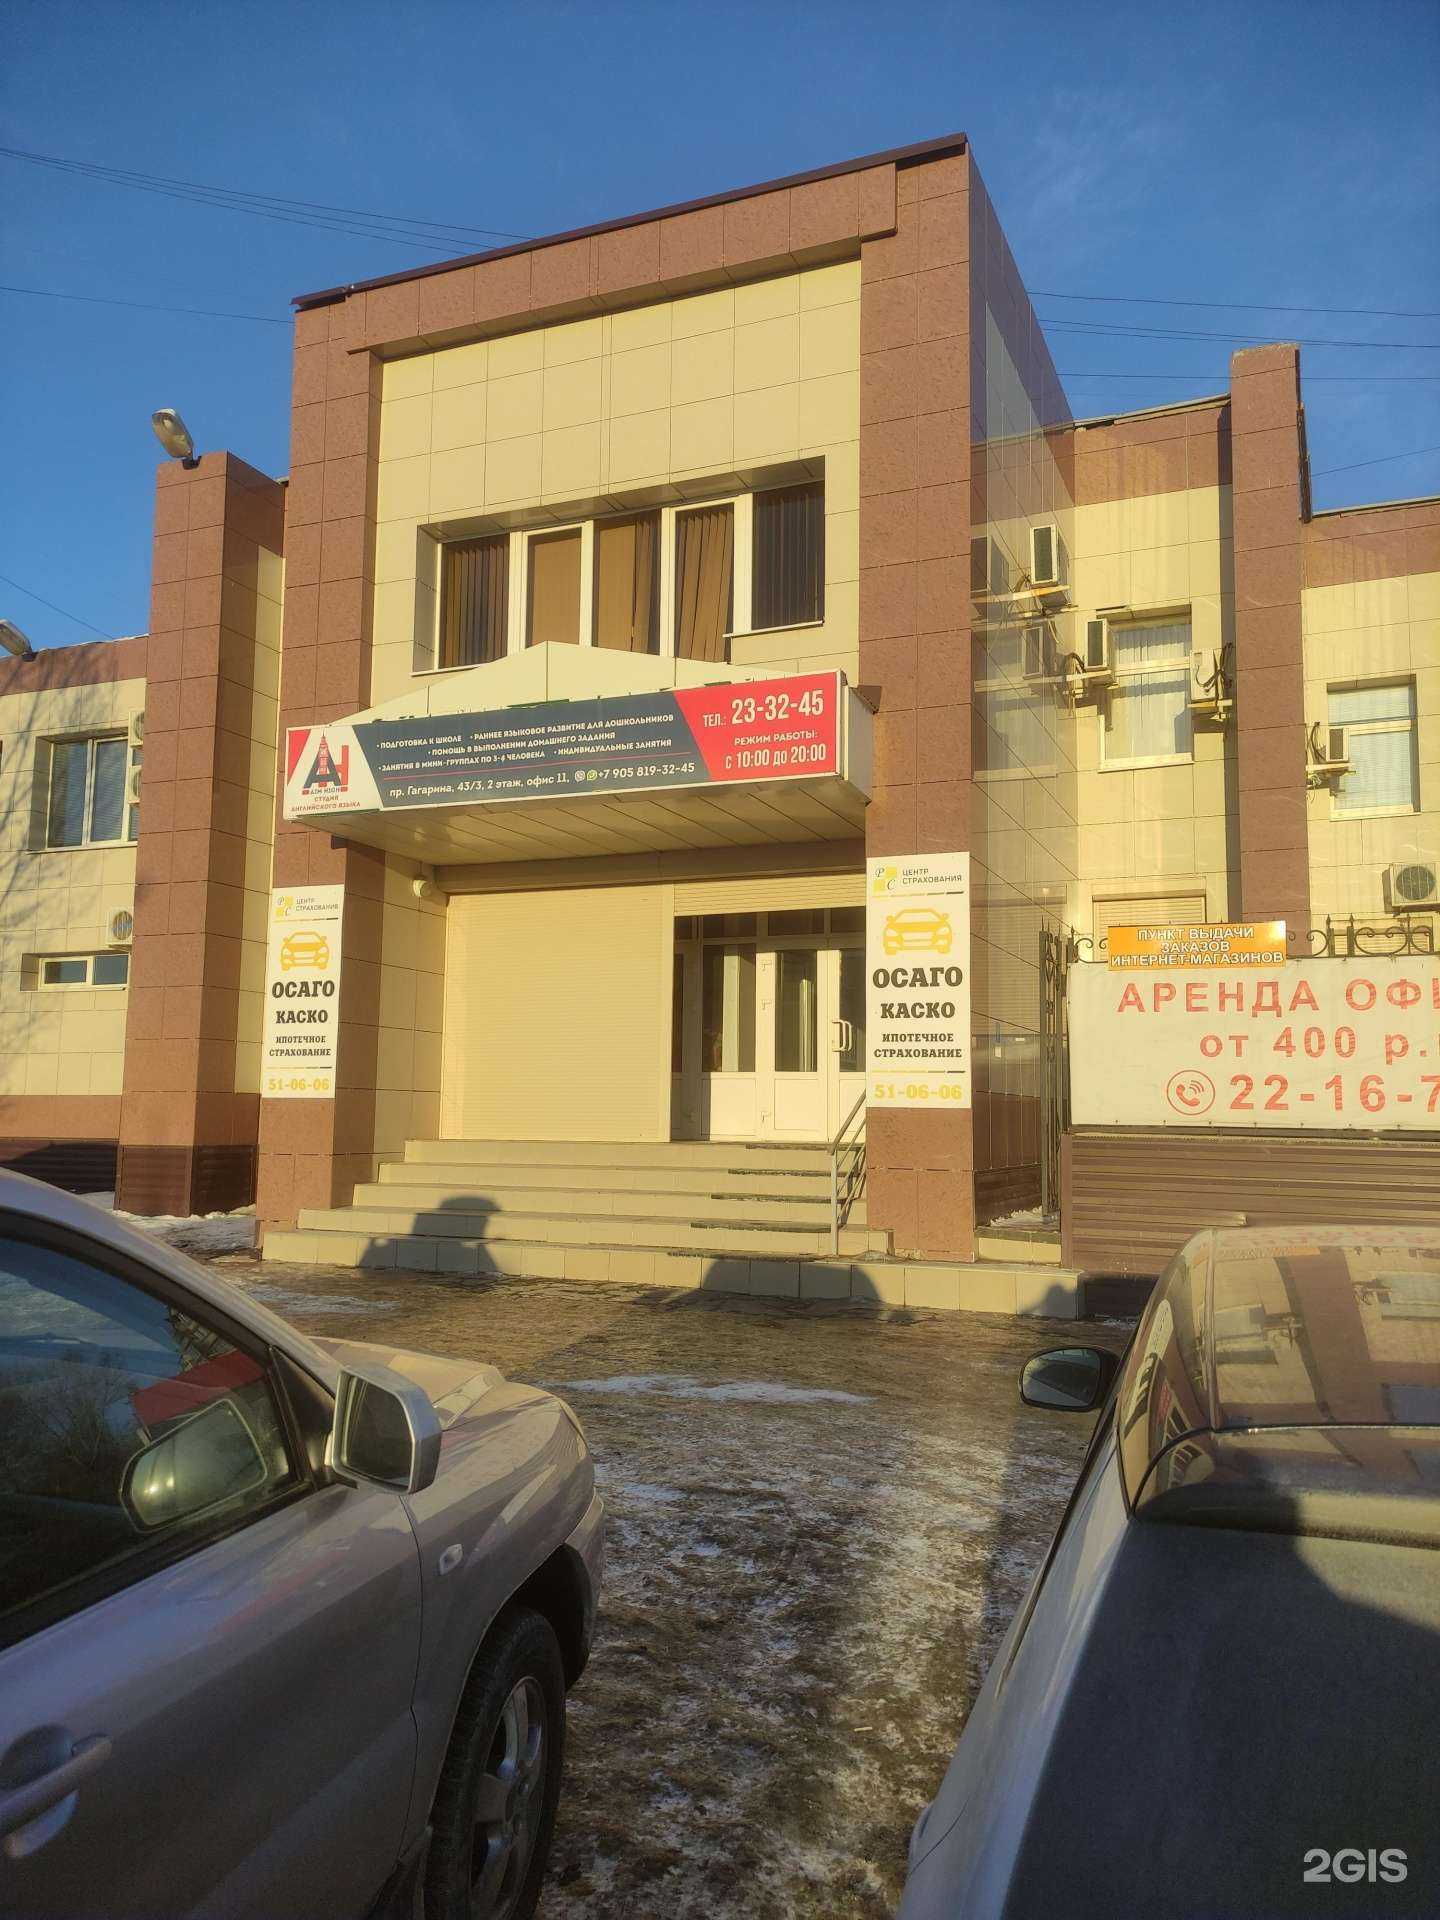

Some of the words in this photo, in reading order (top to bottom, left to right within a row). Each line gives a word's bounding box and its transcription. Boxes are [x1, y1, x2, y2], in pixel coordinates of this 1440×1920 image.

[731, 689, 824, 725] 23-32-45
[381, 738, 428, 749] ПОДГОТОВКА
[436, 735, 462, 744] ШКОЛЕ
[474, 731, 503, 741] РАННЕЕ
[504, 727, 545, 738] ЯЗЫКОВОЕ
[547, 722, 586, 733] РАЗВИТИЕ
[587, 720, 603, 730] ДЛЯ
[605, 714, 674, 727] ДОШКОЛЬНИКОВ
[735, 735, 770, 746] РЕЖИМ
[773, 730, 818, 743] РАБОТЫ:
[432, 747, 466, 756] ПОМОЩЬ
[473, 741, 527, 753] ВЫПОЛНЕНИИ
[527, 735, 576, 748] ДОМАШНЕГО
[578, 732, 615, 742] ЗАДАНИЯ
[382, 763, 414, 772] ЗАНЯТИЯ
[422, 757, 480, 769] МИНИ-ГРУППАХ
[481, 755, 491, 763] ПО
[493, 754, 505, 763] 3-4
[507, 750, 545, 761] ЧЕЛОВЕКА
[558, 743, 633, 756] ИНДИВИДУАЛЬНЫЕ
[636, 739, 672, 749] ЗАНЯТИЯ
[737, 749, 770, 768] 10:00
[790, 743, 826, 763] 20:00
[390, 788, 405, 799] пр.
[487, 780, 493, 789] 2
[527, 774, 555, 788] офис
[612, 767, 634, 778] 905
[636, 762, 695, 777] 819-32-45
[291, 803, 337, 812] АНГЛИЙСКОГО
[902, 868, 928, 877] ЦЕНТР
[902, 875, 962, 885] СТРАХОВАНИЯ
[1137, 928, 1185, 941] ПУНКТ
[1189, 926, 1254, 941] ВЫДАЧИ
[1161, 941, 1230, 953] ЗАКАЗОВ
[1111, 951, 1284, 967] ИНТЕРНЕТ-МАГАЗИНОВ
[872, 967, 963, 988] ОСАГО
[272, 980, 335, 998] ОСАГО
[1116, 979, 1320, 1018] АРЕНДА
[276, 1009, 328, 1024] КАСКО
[880, 1002, 956, 1019] КАСКО
[276, 1035, 326, 1044] ИПОТЕЧНОЕ
[882, 1033, 954, 1043] ИПОТЕЧНОЕ
[1199, 1034, 1249, 1058] от
[1273, 1026, 1357, 1059] 400
[269, 1049, 331, 1057] СТРАХОВАНИЕ
[873, 1048, 962, 1058] СТРАХОВАНИЕ
[268, 1078, 329, 1091] 51-06-06
[874, 1084, 962, 1099] 51-06-06
